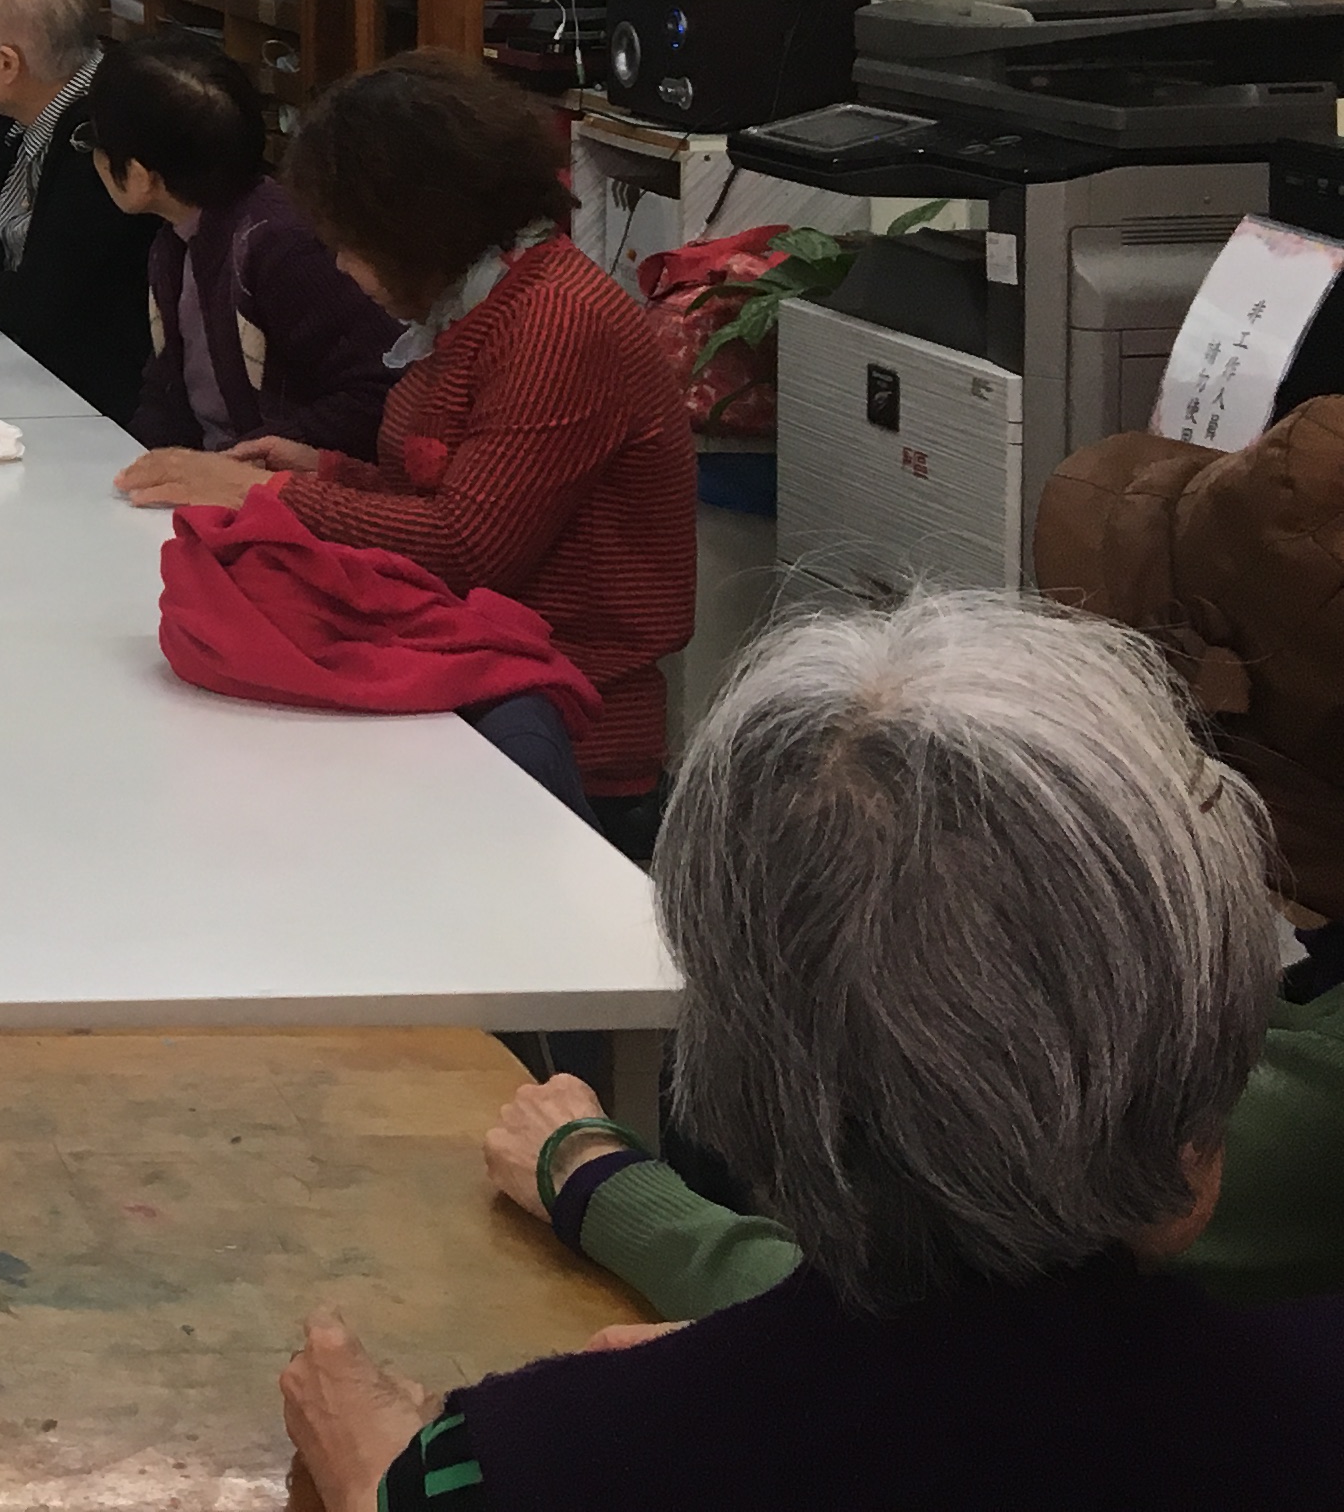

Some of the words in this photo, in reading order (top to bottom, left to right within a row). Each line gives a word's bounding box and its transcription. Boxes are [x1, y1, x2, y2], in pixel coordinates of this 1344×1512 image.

[1204, 299, 1267, 442] 非工作人員
